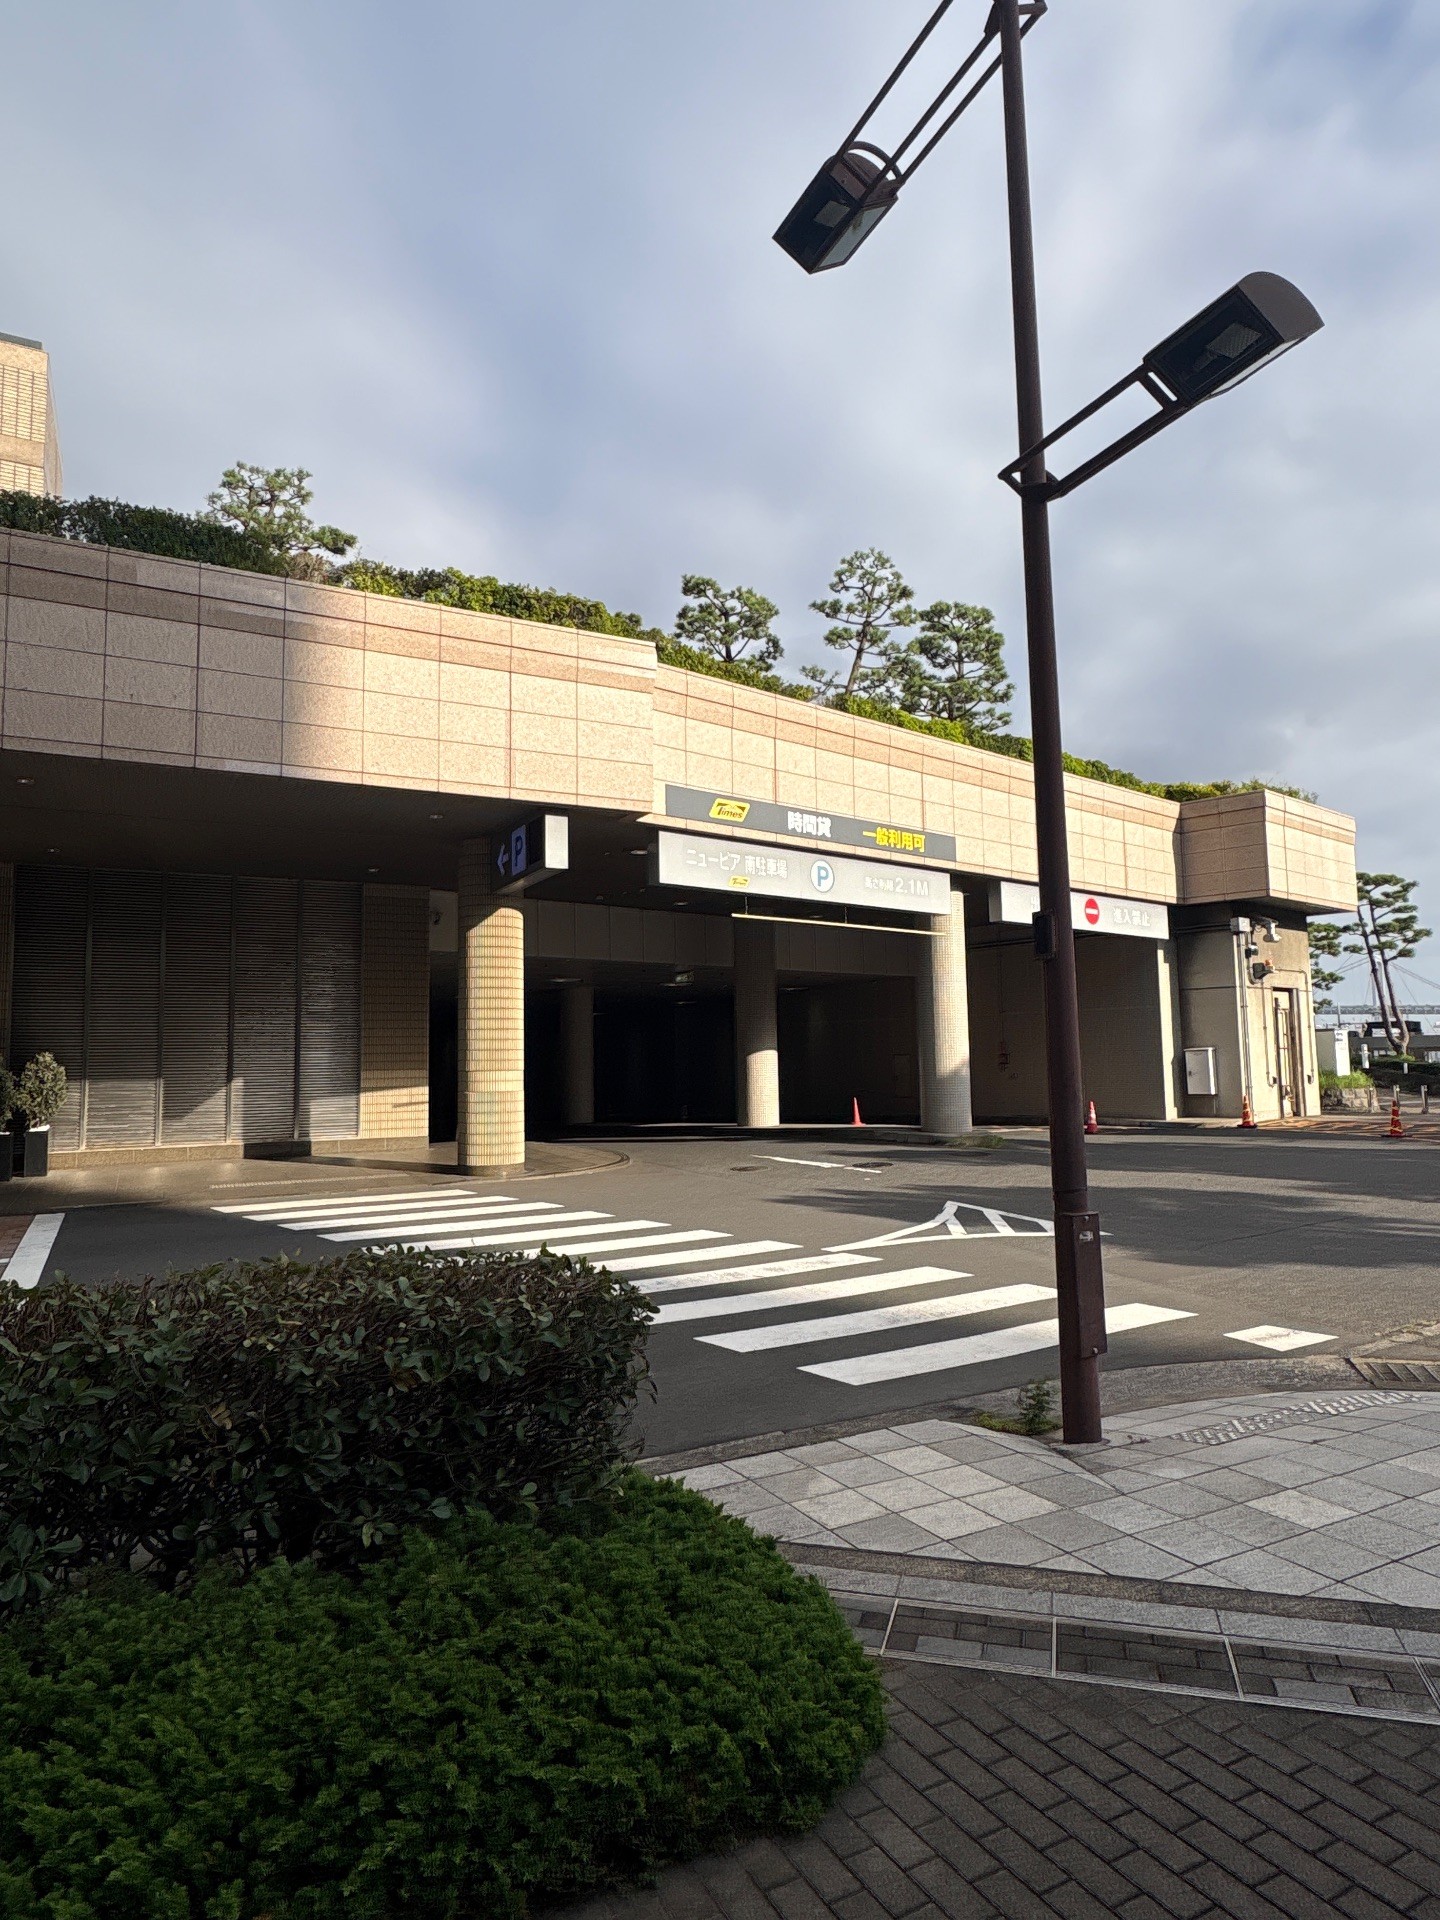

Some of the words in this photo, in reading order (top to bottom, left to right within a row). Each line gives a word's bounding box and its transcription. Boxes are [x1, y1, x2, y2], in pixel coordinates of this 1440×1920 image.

[716, 802, 745, 819] Times
[787, 811, 832, 838] 時間貸
[514, 835, 524, 867] P
[862, 827, 926, 852] 一般利用可
[817, 865, 829, 887] P
